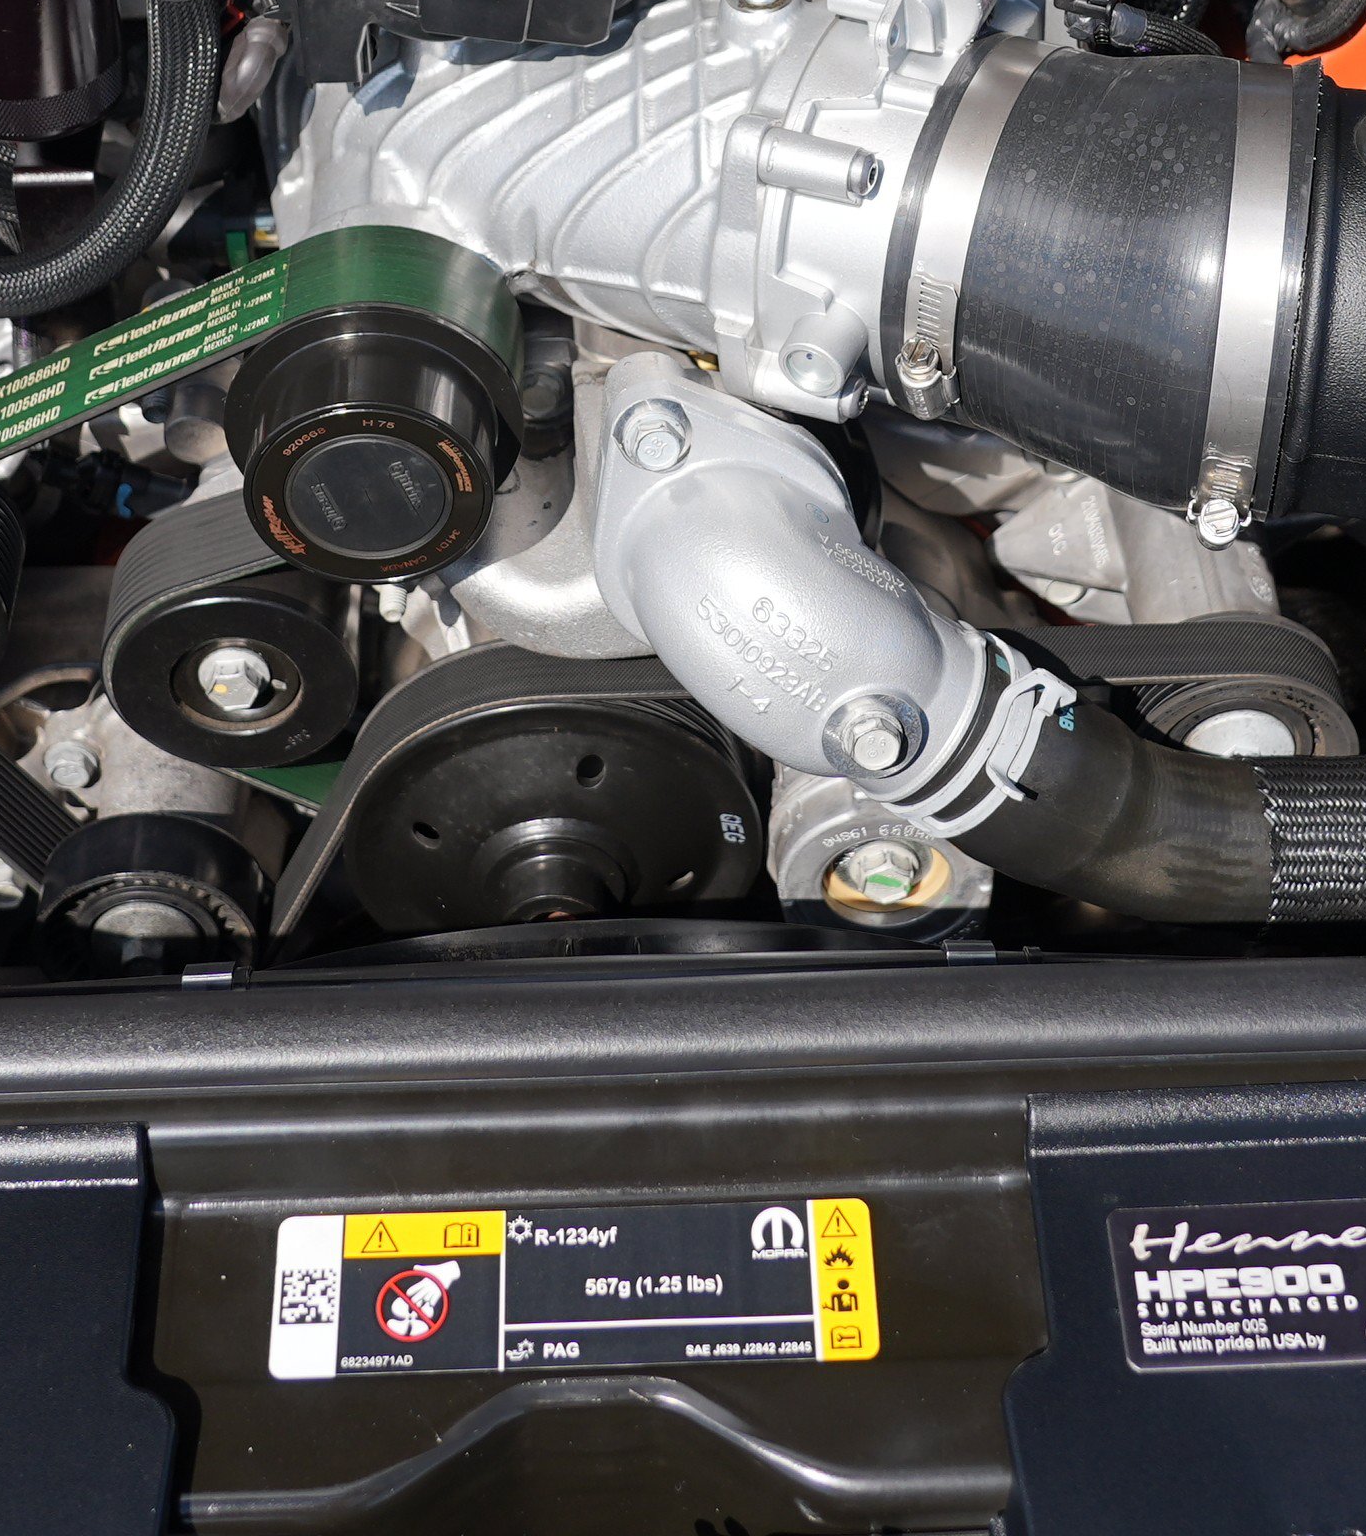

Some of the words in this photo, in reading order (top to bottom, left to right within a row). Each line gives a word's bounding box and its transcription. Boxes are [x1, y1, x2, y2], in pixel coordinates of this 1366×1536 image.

[210, 279, 230, 296] MADE
[232, 276, 244, 287] IN
[210, 286, 240, 304] MEXICO
[123, 298, 211, 344] FleetRunner
[206, 310, 237, 329] MEXICO
[207, 303, 227, 321] MADE
[230, 300, 241, 311] IN
[118, 321, 206, 368] FleetRunner
[202, 334, 234, 353] MEXICO
[203, 327, 224, 345] MADE
[227, 323, 238, 334] IN
[113, 345, 202, 392] FleetRunner
[752, 596, 837, 672] 63325
[534, 1225, 617, 1247] R-1234yf
[751, 1248, 806, 1260] MOPAR
[585, 1275, 630, 1298] 567g
[635, 1274, 682, 1297] (1.25
[687, 1273, 723, 1296] lbs)
[1134, 1263, 1346, 1301] HPE900
[1137, 1294, 1359, 1318] SUPERCHARGED
[1140, 1321, 1181, 1338] Serial
[1182, 1319, 1241, 1337] Number
[1242, 1318, 1268, 1334] 005
[542, 1340, 581, 1360] PAG
[685, 1343, 710, 1357] SAE
[713, 1342, 739, 1356] J639
[742, 1340, 775, 1356] J2842
[778, 1339, 813, 1354] J2845
[1142, 1338, 1177, 1355] Built
[1178, 1335, 1213, 1352] with
[1215, 1335, 1255, 1355] pride
[1257, 1335, 1271, 1349] in
[1273, 1332, 1307, 1350] USA
[1307, 1331, 1326, 1352] by
[340, 1352, 414, 1368] 68234971AD
